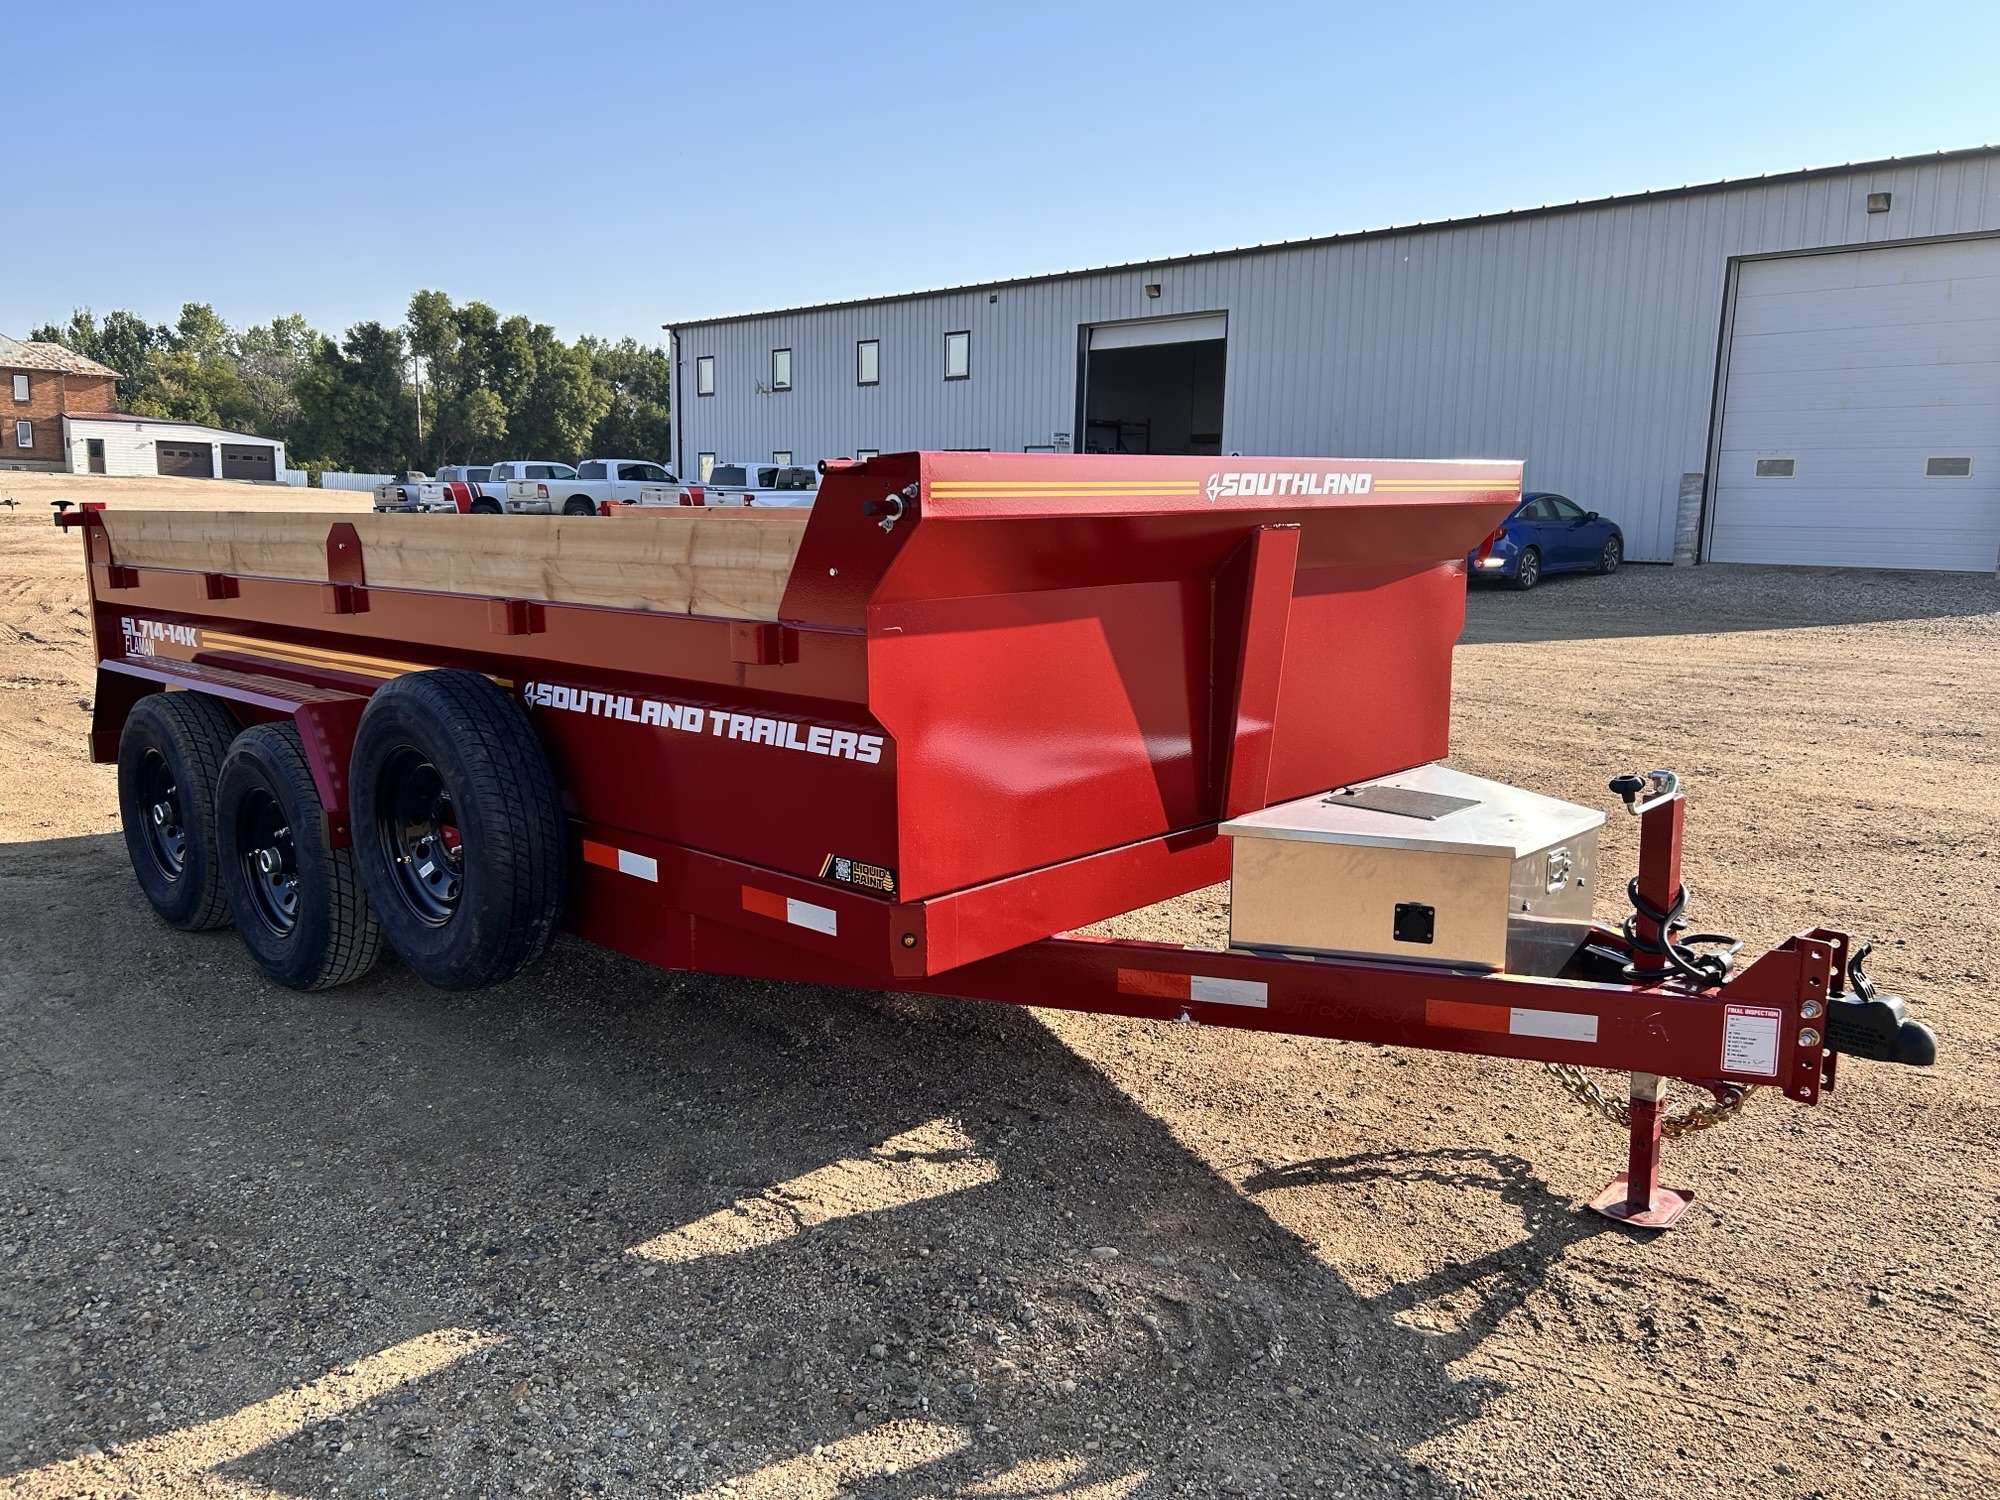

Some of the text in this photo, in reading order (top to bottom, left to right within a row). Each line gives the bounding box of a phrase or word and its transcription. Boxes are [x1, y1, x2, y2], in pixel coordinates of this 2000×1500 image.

[1220, 472, 1372, 496] SOUTHLAND
[121, 616, 198, 648] SL714-14K
[125, 635, 155, 657] FLAMAN
[536, 683, 884, 764] SOUTHLAND TRAILERS
[853, 861, 887, 880] LIQUID
[853, 872, 883, 889] PAINT
[1727, 1007, 1779, 1018] FINAL INSPECTION
